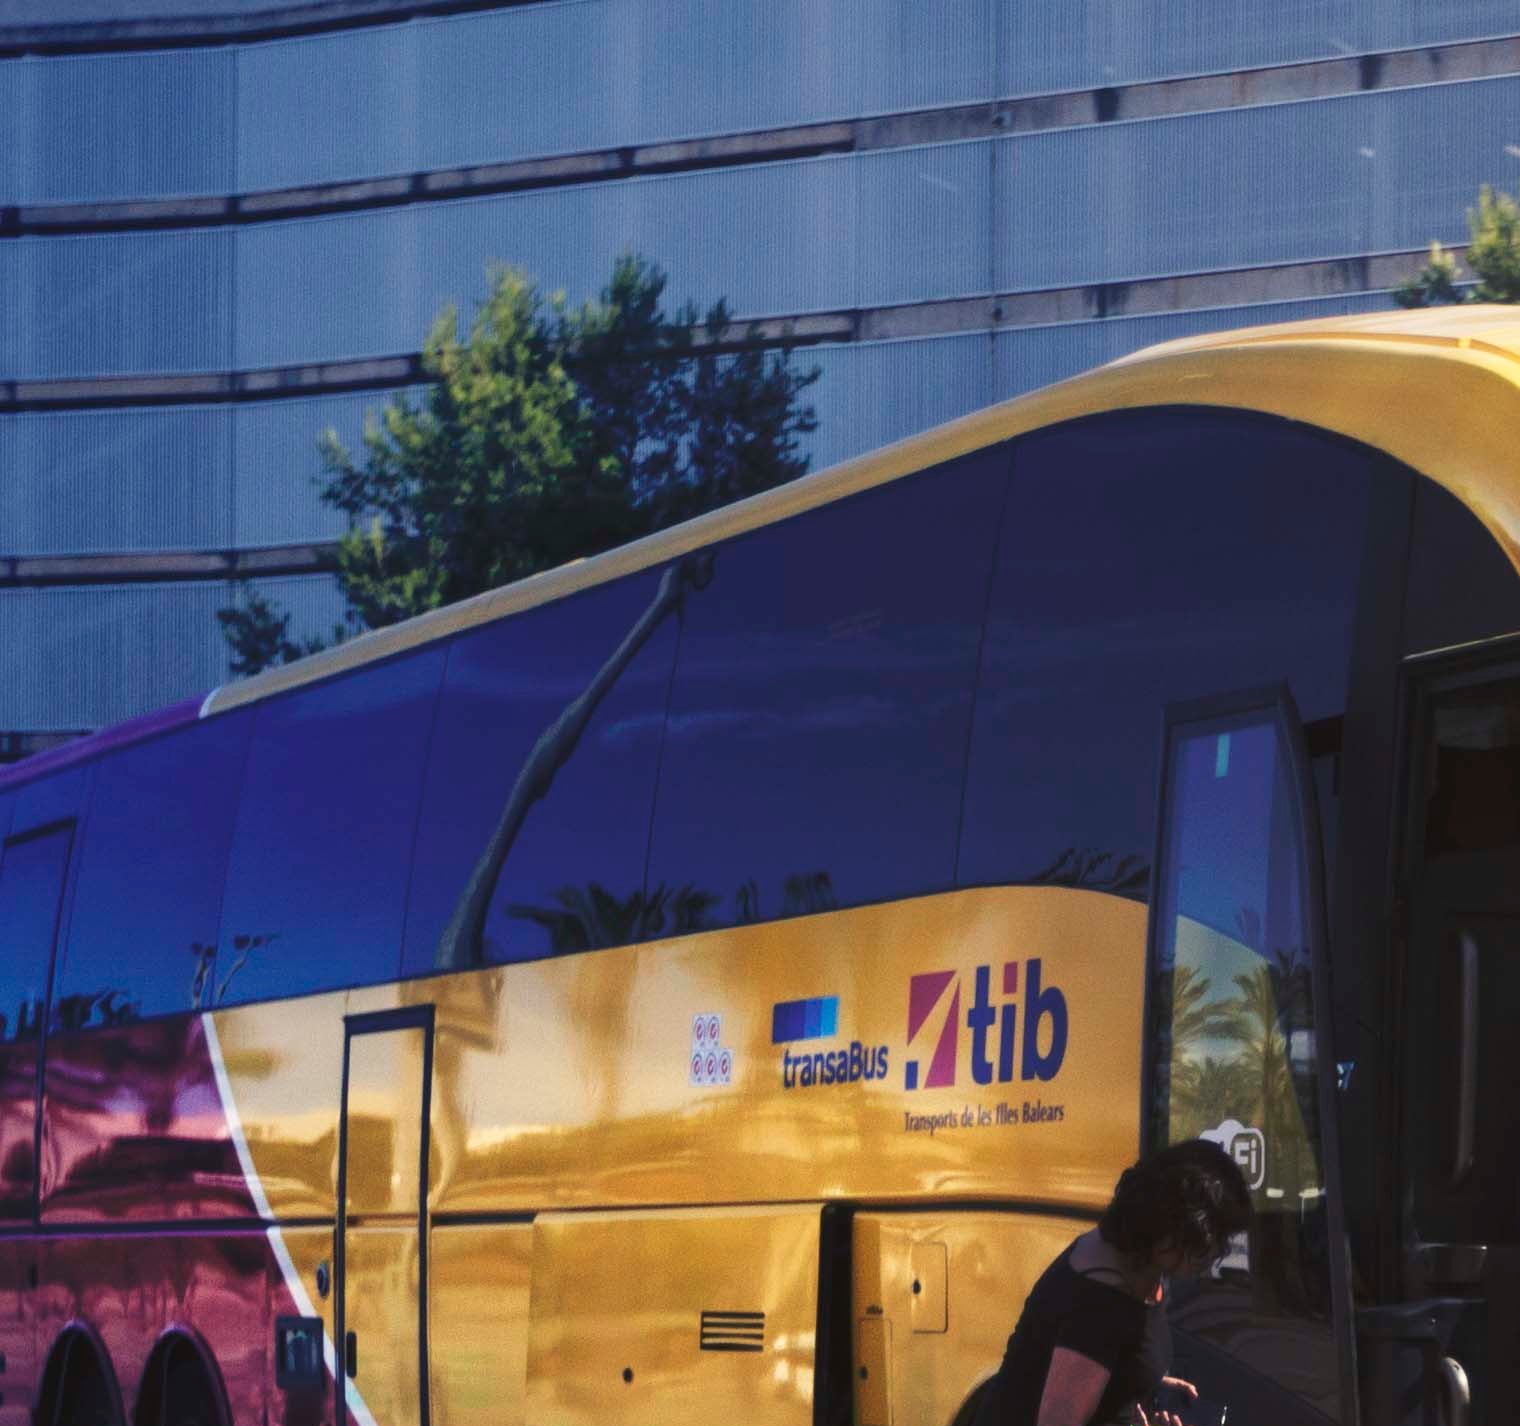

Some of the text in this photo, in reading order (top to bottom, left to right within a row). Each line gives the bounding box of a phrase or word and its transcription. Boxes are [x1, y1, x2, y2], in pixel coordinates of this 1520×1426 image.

[967, 957, 1069, 1086] tib
[783, 1040, 889, 1089] transaBus
[904, 1100, 1065, 1136] Transports de les Illes Balears
